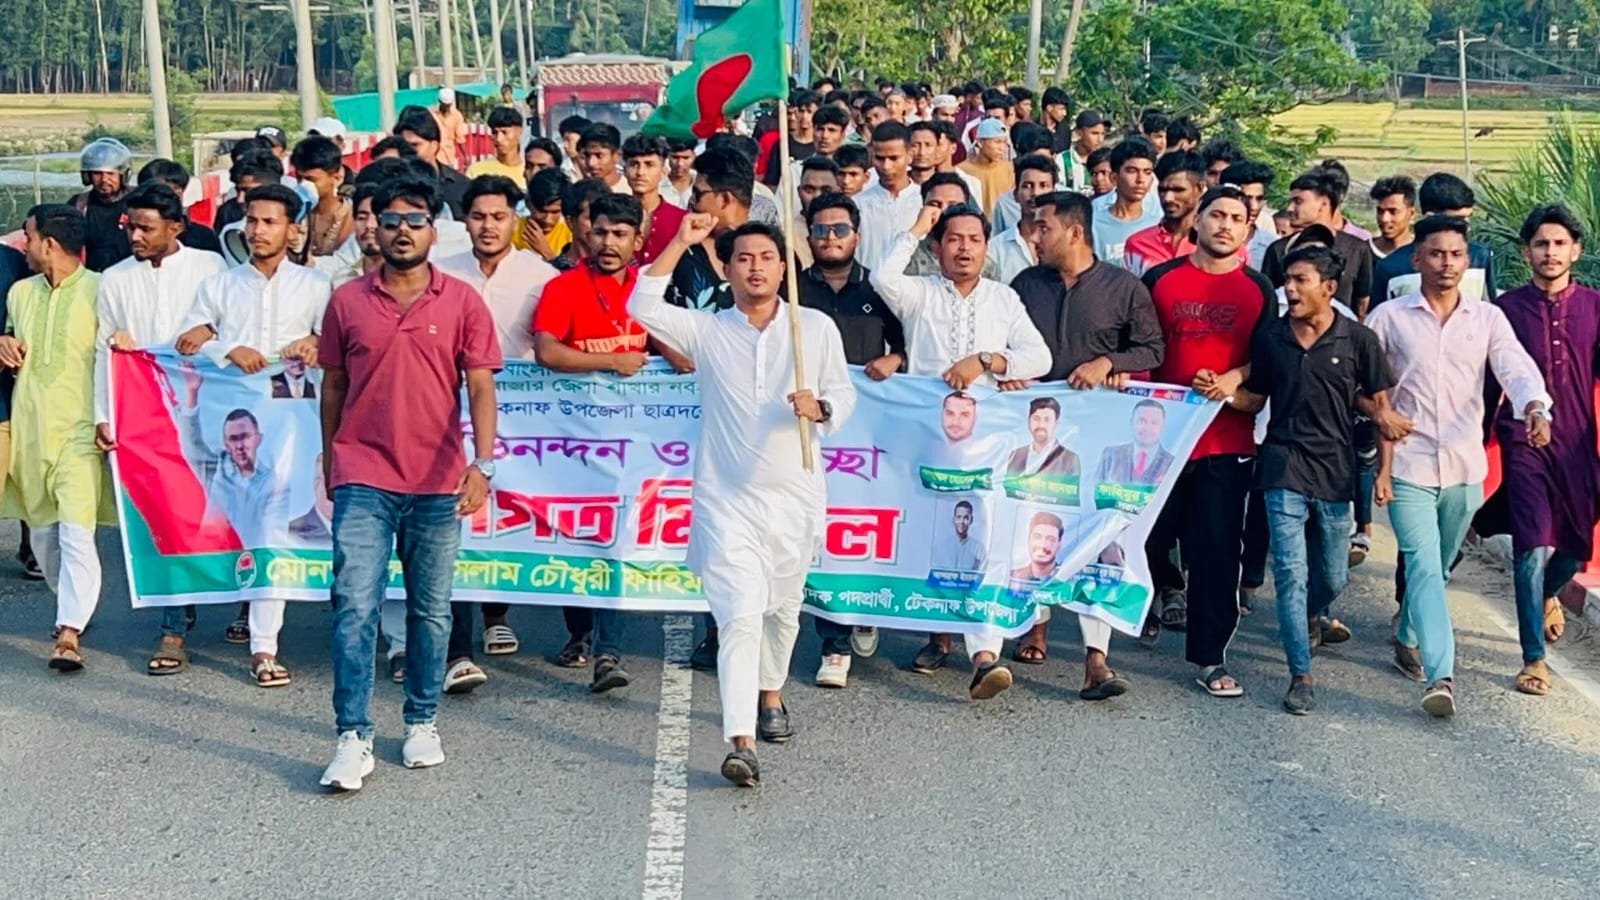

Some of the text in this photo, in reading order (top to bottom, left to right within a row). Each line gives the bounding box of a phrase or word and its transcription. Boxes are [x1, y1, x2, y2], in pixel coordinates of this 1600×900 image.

[552, 378, 597, 395] জেলা
[497, 401, 552, 416] কনাফ
[558, 398, 634, 419] উপজেলা
[650, 440, 690, 467] ও
[454, 558, 523, 587] সলাম
[530, 555, 614, 596] চৌধুরী
[905, 593, 961, 614] টেকনাফ
[964, 599, 1020, 625] উপজেলা
